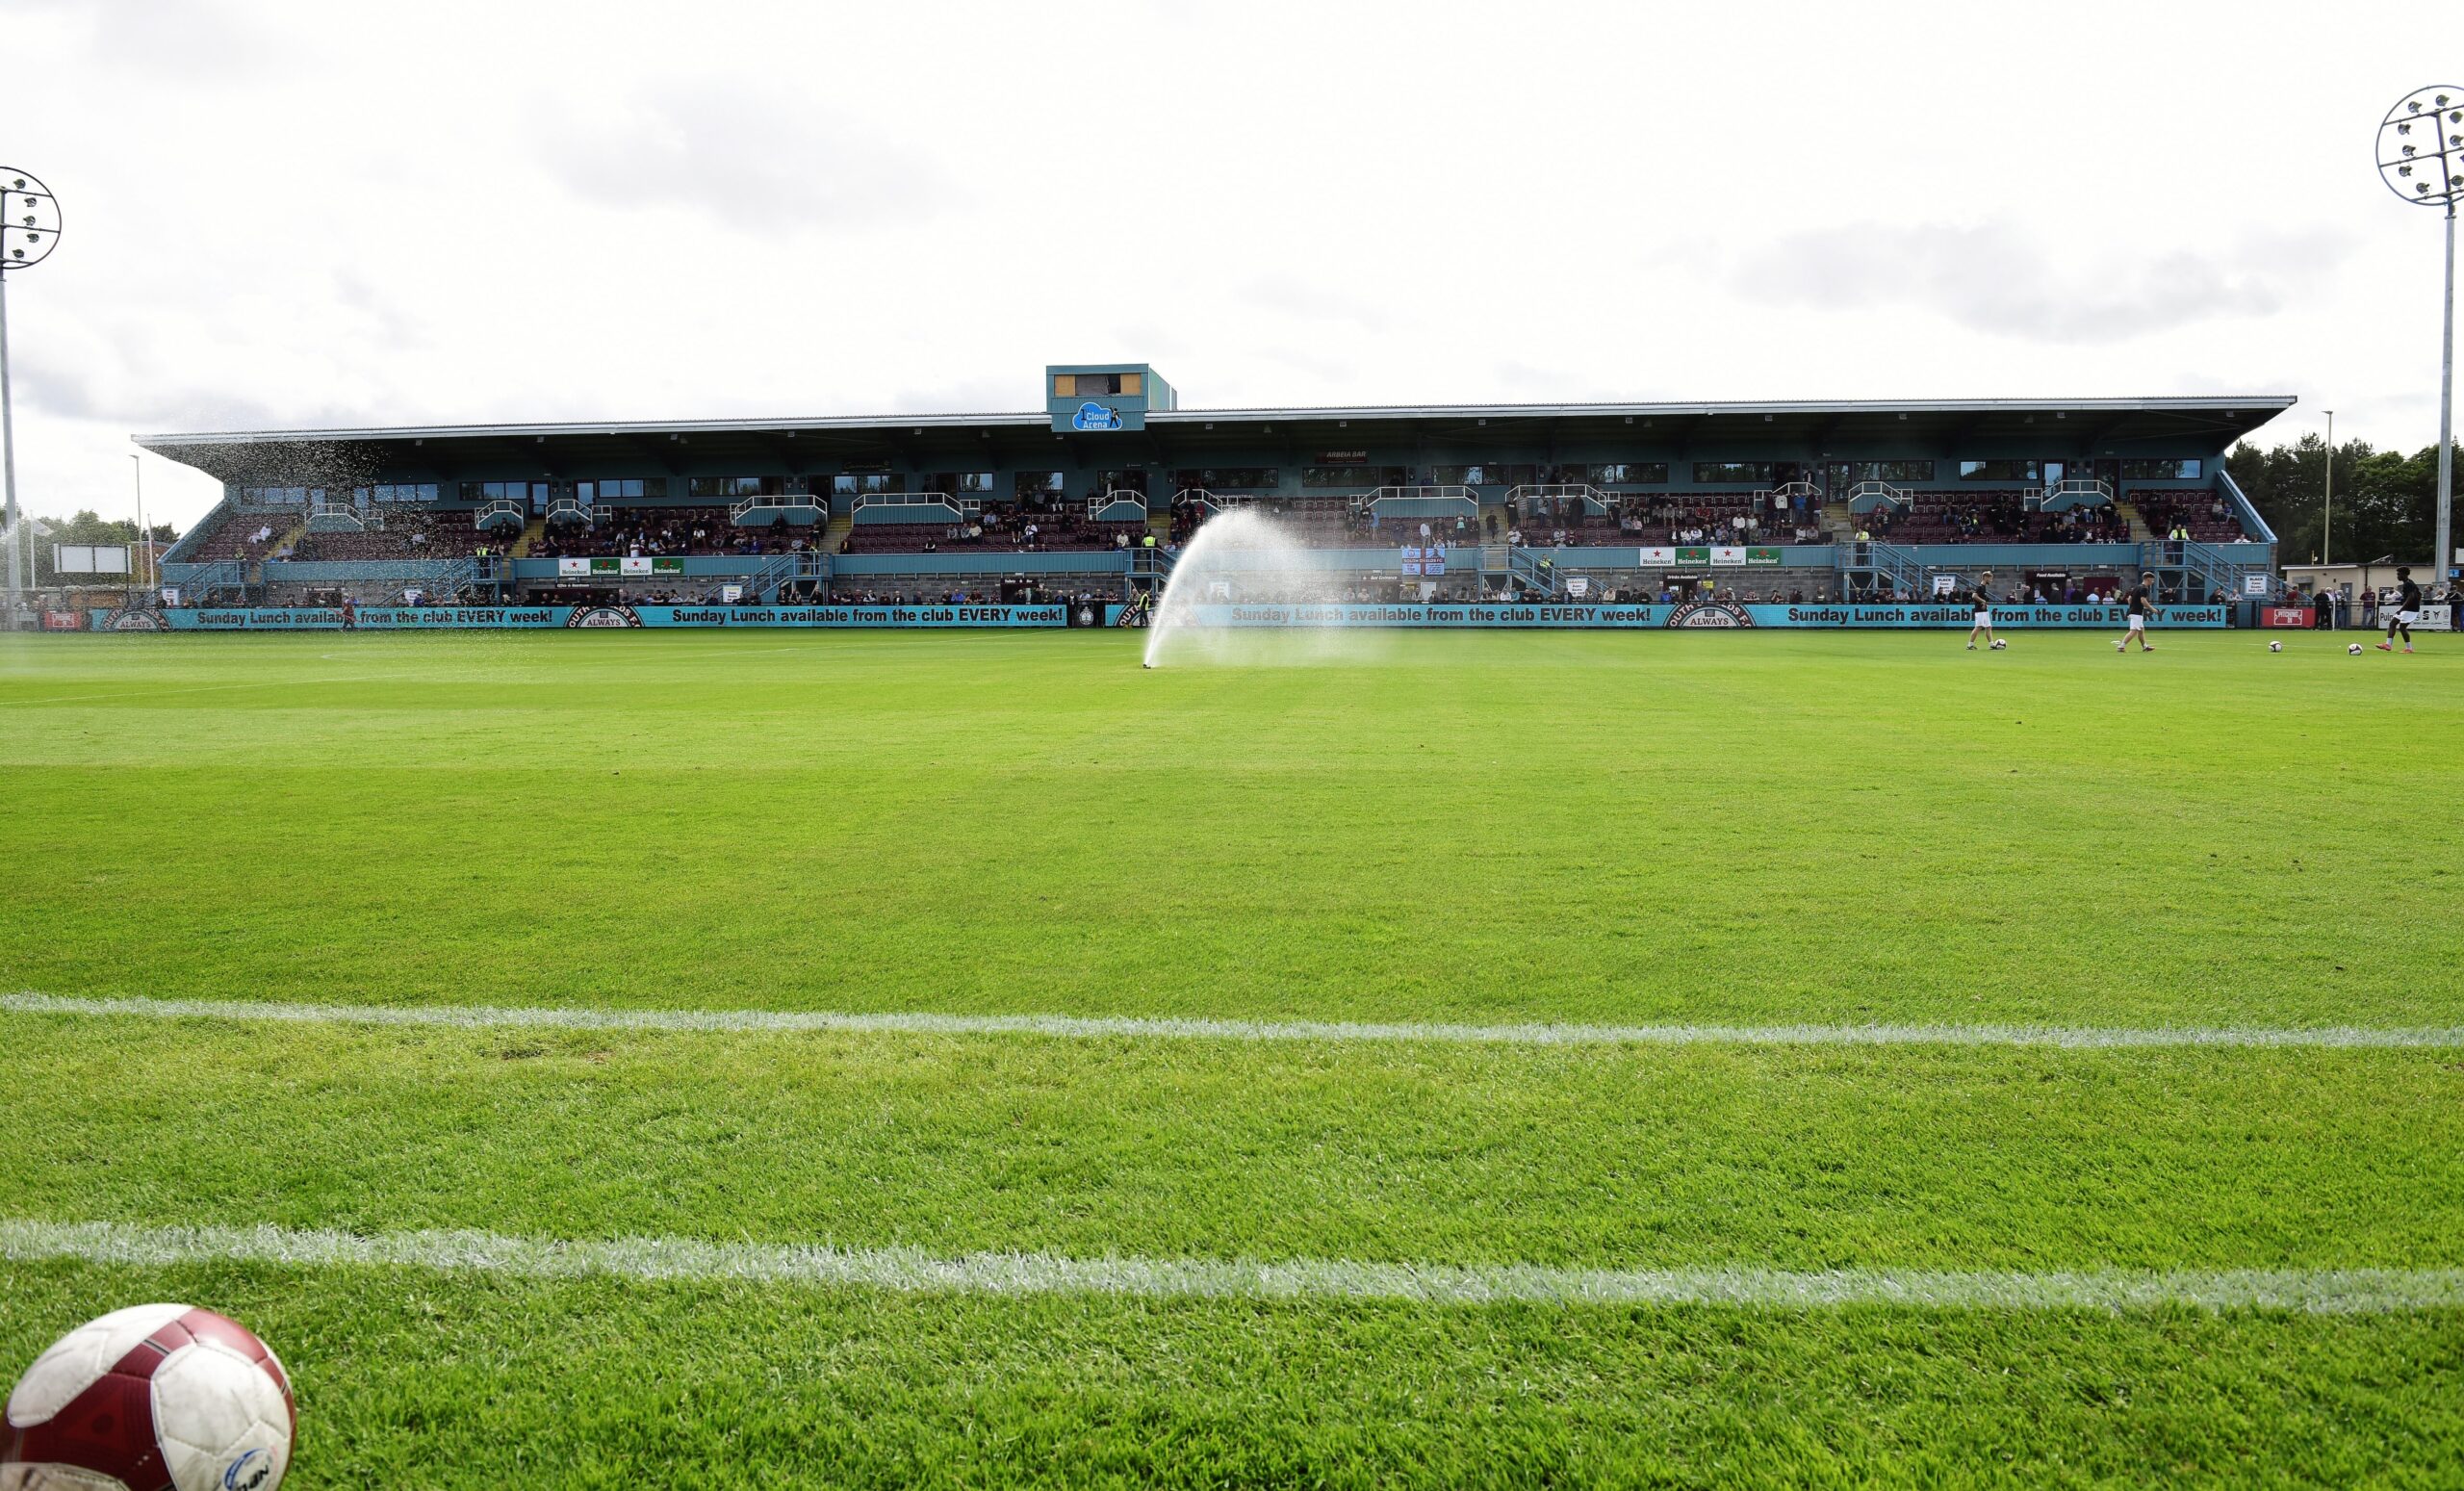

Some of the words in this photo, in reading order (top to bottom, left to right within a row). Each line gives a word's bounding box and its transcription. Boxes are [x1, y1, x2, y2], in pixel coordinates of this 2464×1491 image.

[1087, 412, 1110, 421] Cloud
[1083, 421, 1108, 429] Arena
[197, 611, 246, 626] Sunday
[250, 610, 291, 624] Lunch
[361, 610, 392, 624] from
[396, 610, 419, 624] the
[423, 610, 453, 624] club
[457, 610, 505, 623] EVERY
[510, 610, 552, 623] week!
[672, 608, 727, 625] Sunday
[731, 608, 776, 623] Lunch
[781, 608, 848, 622] available
[853, 608, 887, 622] from
[892, 608, 917, 622] the
[922, 607, 954, 622] club
[960, 607, 1012, 621] EVERY
[1016, 607, 1063, 621] week!
[1233, 607, 1290, 624] Sunday
[1296, 607, 1344, 621] Lunch
[1349, 607, 1422, 621] available
[1425, 607, 1464, 621] from
[1469, 607, 1496, 621] the
[1500, 607, 1535, 621] club
[1541, 607, 1596, 621] EVERY
[1601, 607, 1651, 621] week!
[1788, 607, 1850, 625] Sunday
[1854, 607, 1905, 622] Lunch
[1990, 607, 2030, 622] from
[2035, 607, 2063, 622] the
[2066, 607, 2103, 622] club
[2109, 608, 2167, 622] EVRY
[2171, 607, 2221, 622] week!
